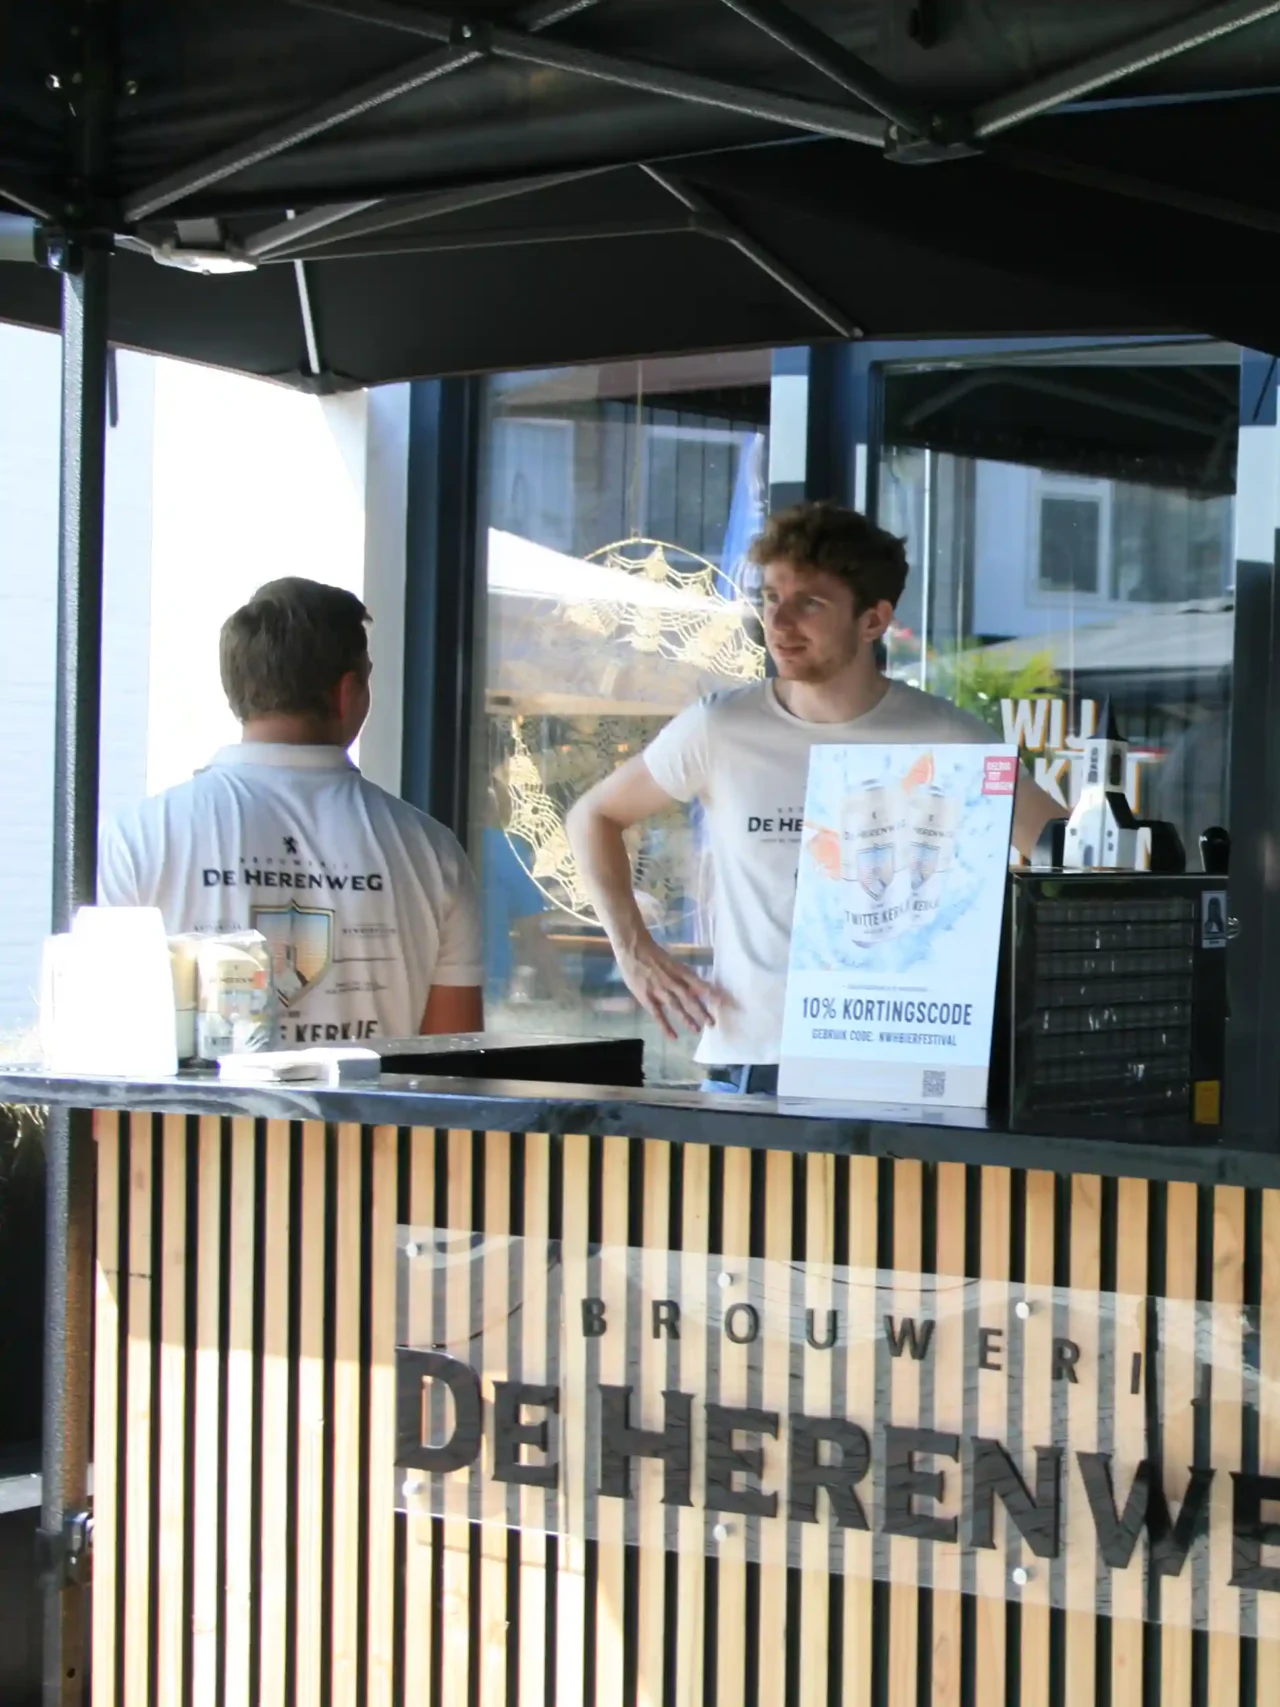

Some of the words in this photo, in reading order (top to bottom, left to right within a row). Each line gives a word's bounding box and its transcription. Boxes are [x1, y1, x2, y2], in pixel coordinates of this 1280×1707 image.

[1001, 699, 1097, 751] WIJ
[748, 816, 774, 833] DE
[203, 868, 236, 887] DE
[244, 869, 384, 892] HERENWEG
[803, 997, 837, 1019] 10%
[842, 998, 973, 1026] KORTINGSCODE
[812, 1028, 847, 1041] GEBRUIK
[394, 1346, 560, 1489] DE
